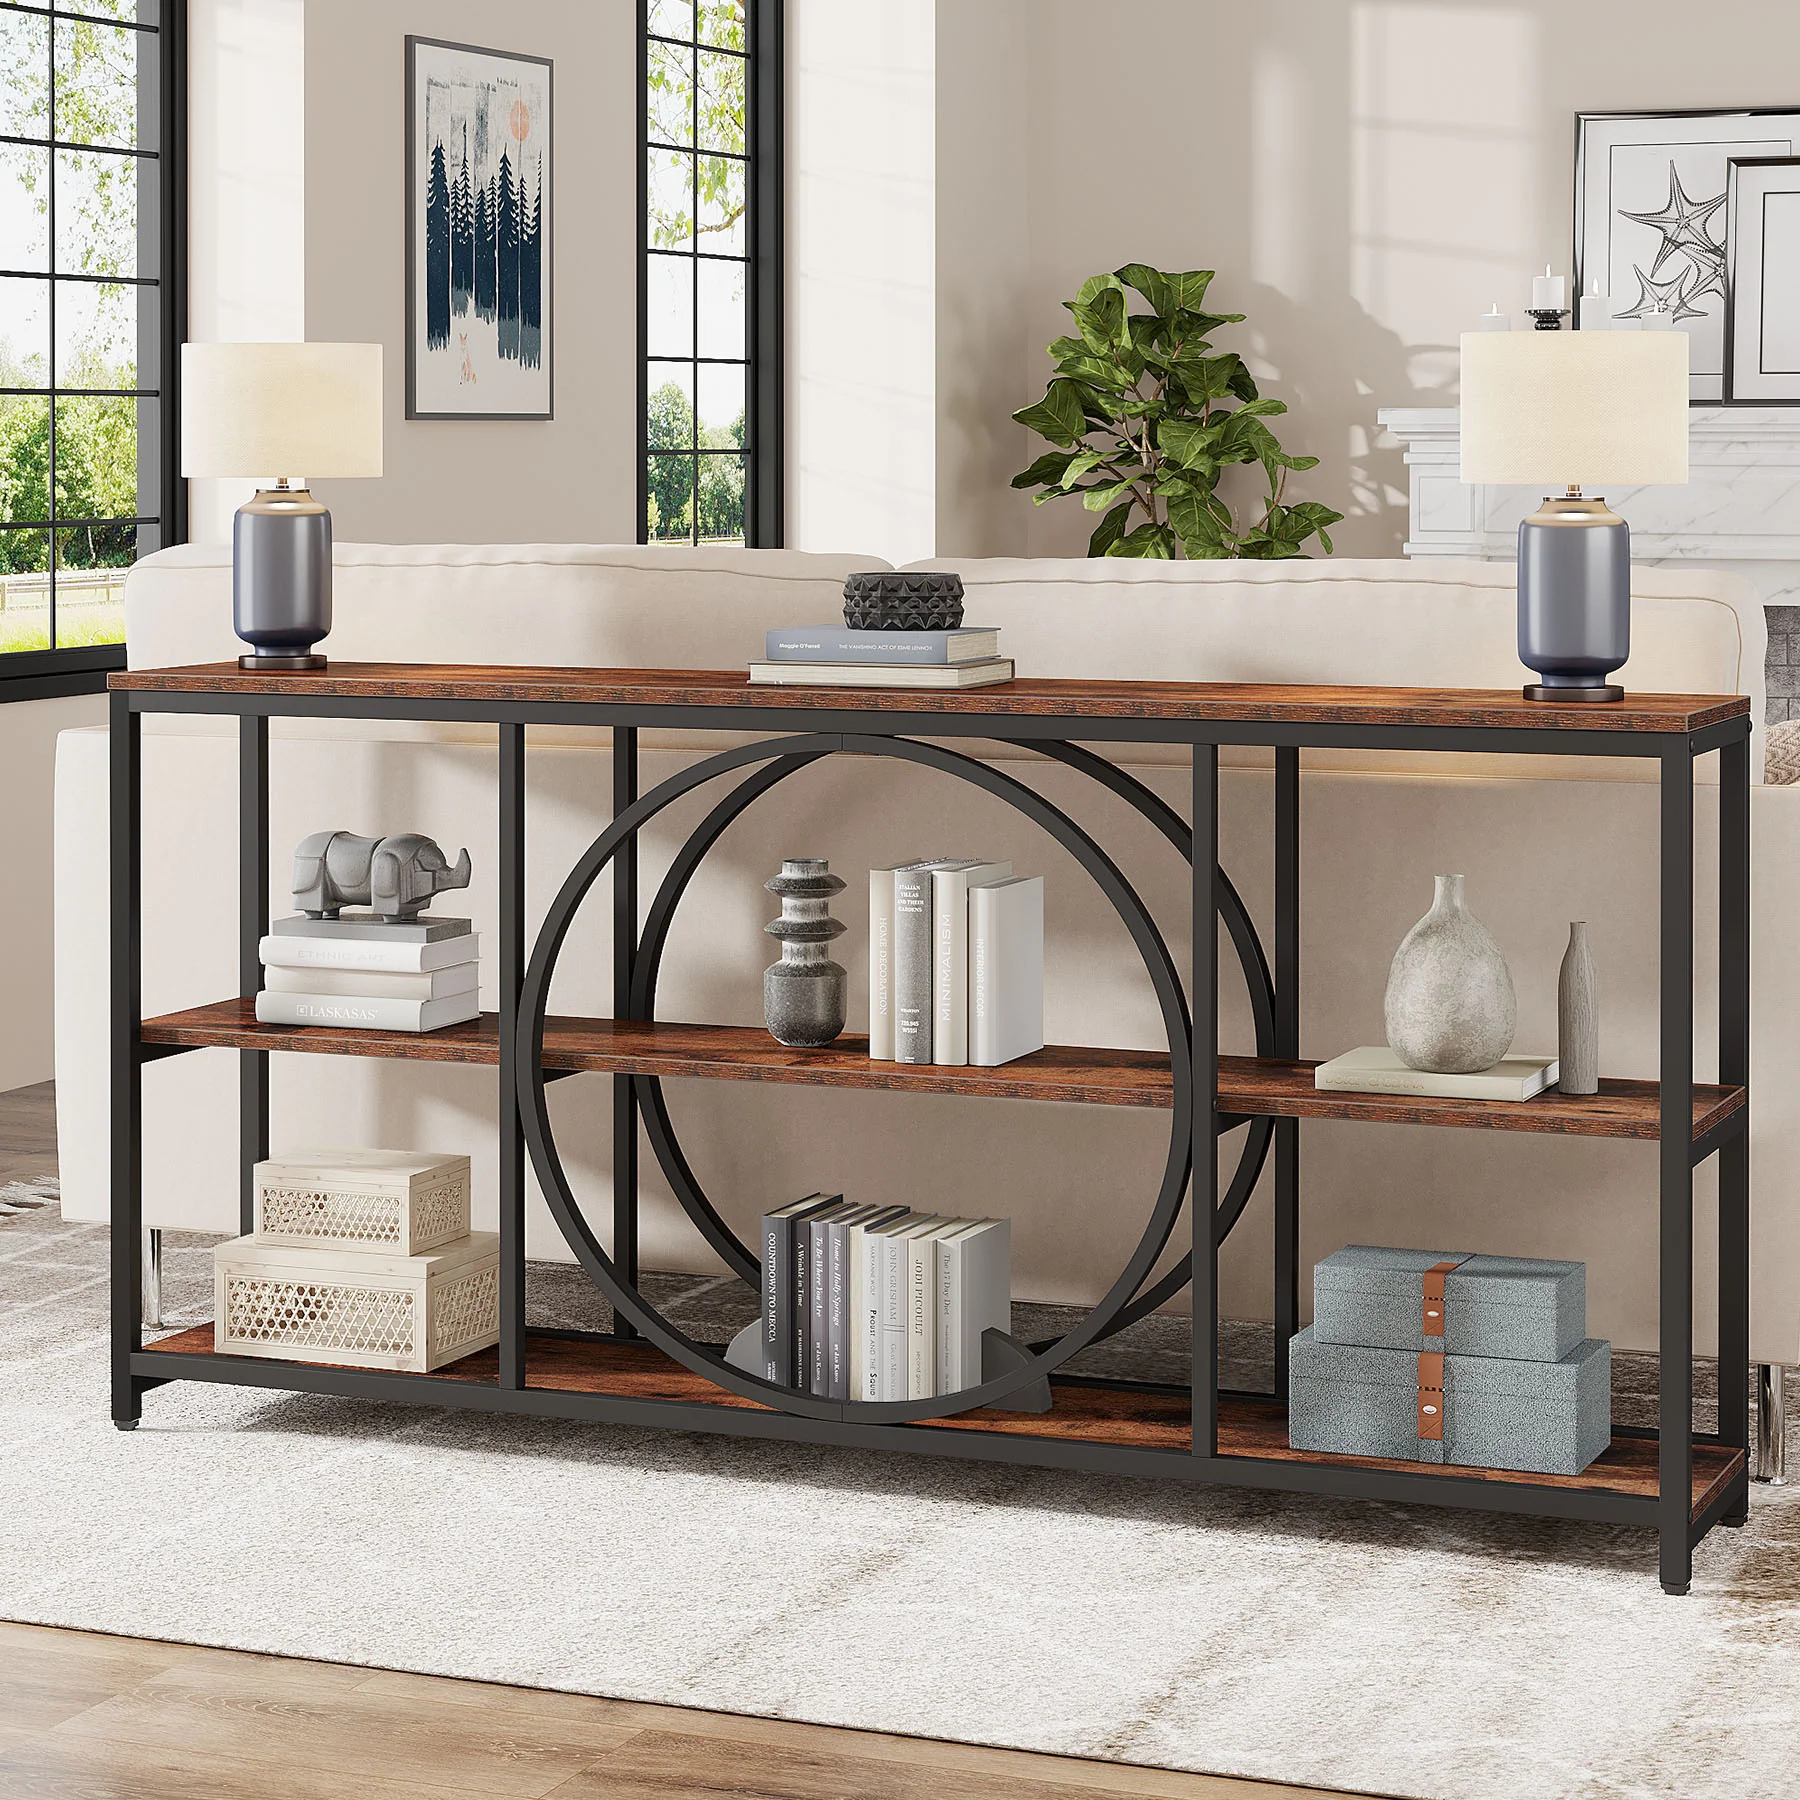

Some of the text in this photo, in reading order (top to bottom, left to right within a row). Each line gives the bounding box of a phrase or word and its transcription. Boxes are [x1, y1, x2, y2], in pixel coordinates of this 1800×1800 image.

[879, 917, 888, 1015] HOME DECORATION
[941, 913, 951, 1020] MINIMALISM
[976, 937, 985, 1017] INTERIOR DECOR
[310, 1005, 377, 1020] LASKASAS
[797, 1250, 805, 1279] Wrinkle
[943, 1253, 951, 1269] The
[944, 1270, 951, 1280] 17
[768, 1232, 777, 1343] COUNTDOWN TO MECCA
[797, 1280, 804, 1288] in
[815, 1236, 824, 1318] To Be Where You Are
[832, 1239, 842, 1327] Home to Holly Springs
[889, 1246, 897, 1321] JOHN GRISHAM
[943, 1281, 951, 1297] Day
[797, 1289, 805, 1307] Time
[915, 1259, 923, 1336] JODI PICOULT
[943, 1298, 951, 1316] Diet
[914, 1374, 922, 1395] glance
